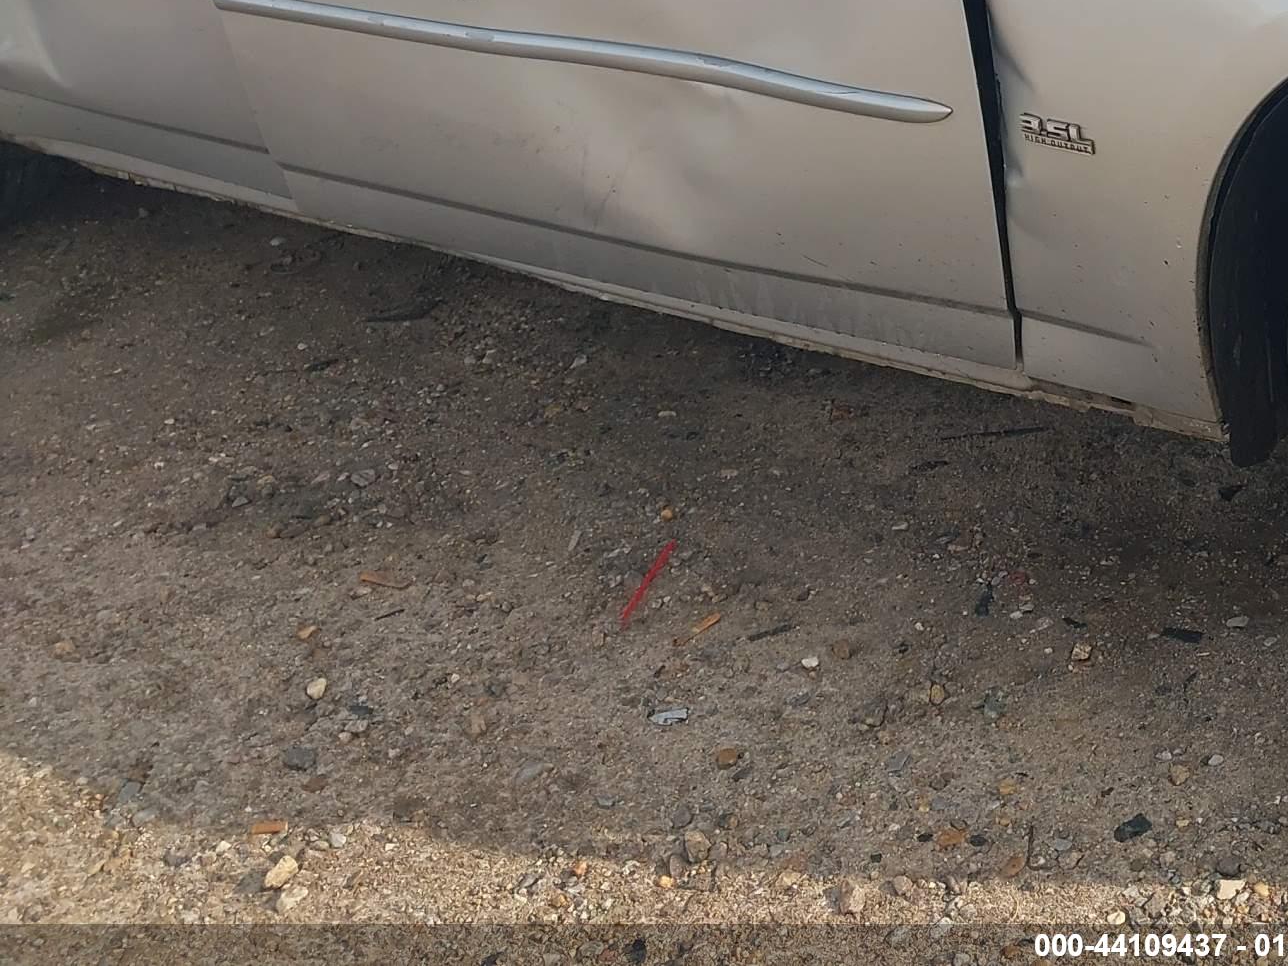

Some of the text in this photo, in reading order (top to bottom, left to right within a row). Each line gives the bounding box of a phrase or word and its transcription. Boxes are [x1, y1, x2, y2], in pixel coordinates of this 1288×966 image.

[1019, 112, 1095, 149] 3.5L
[1024, 133, 1092, 154] HIGH OUTPUT
